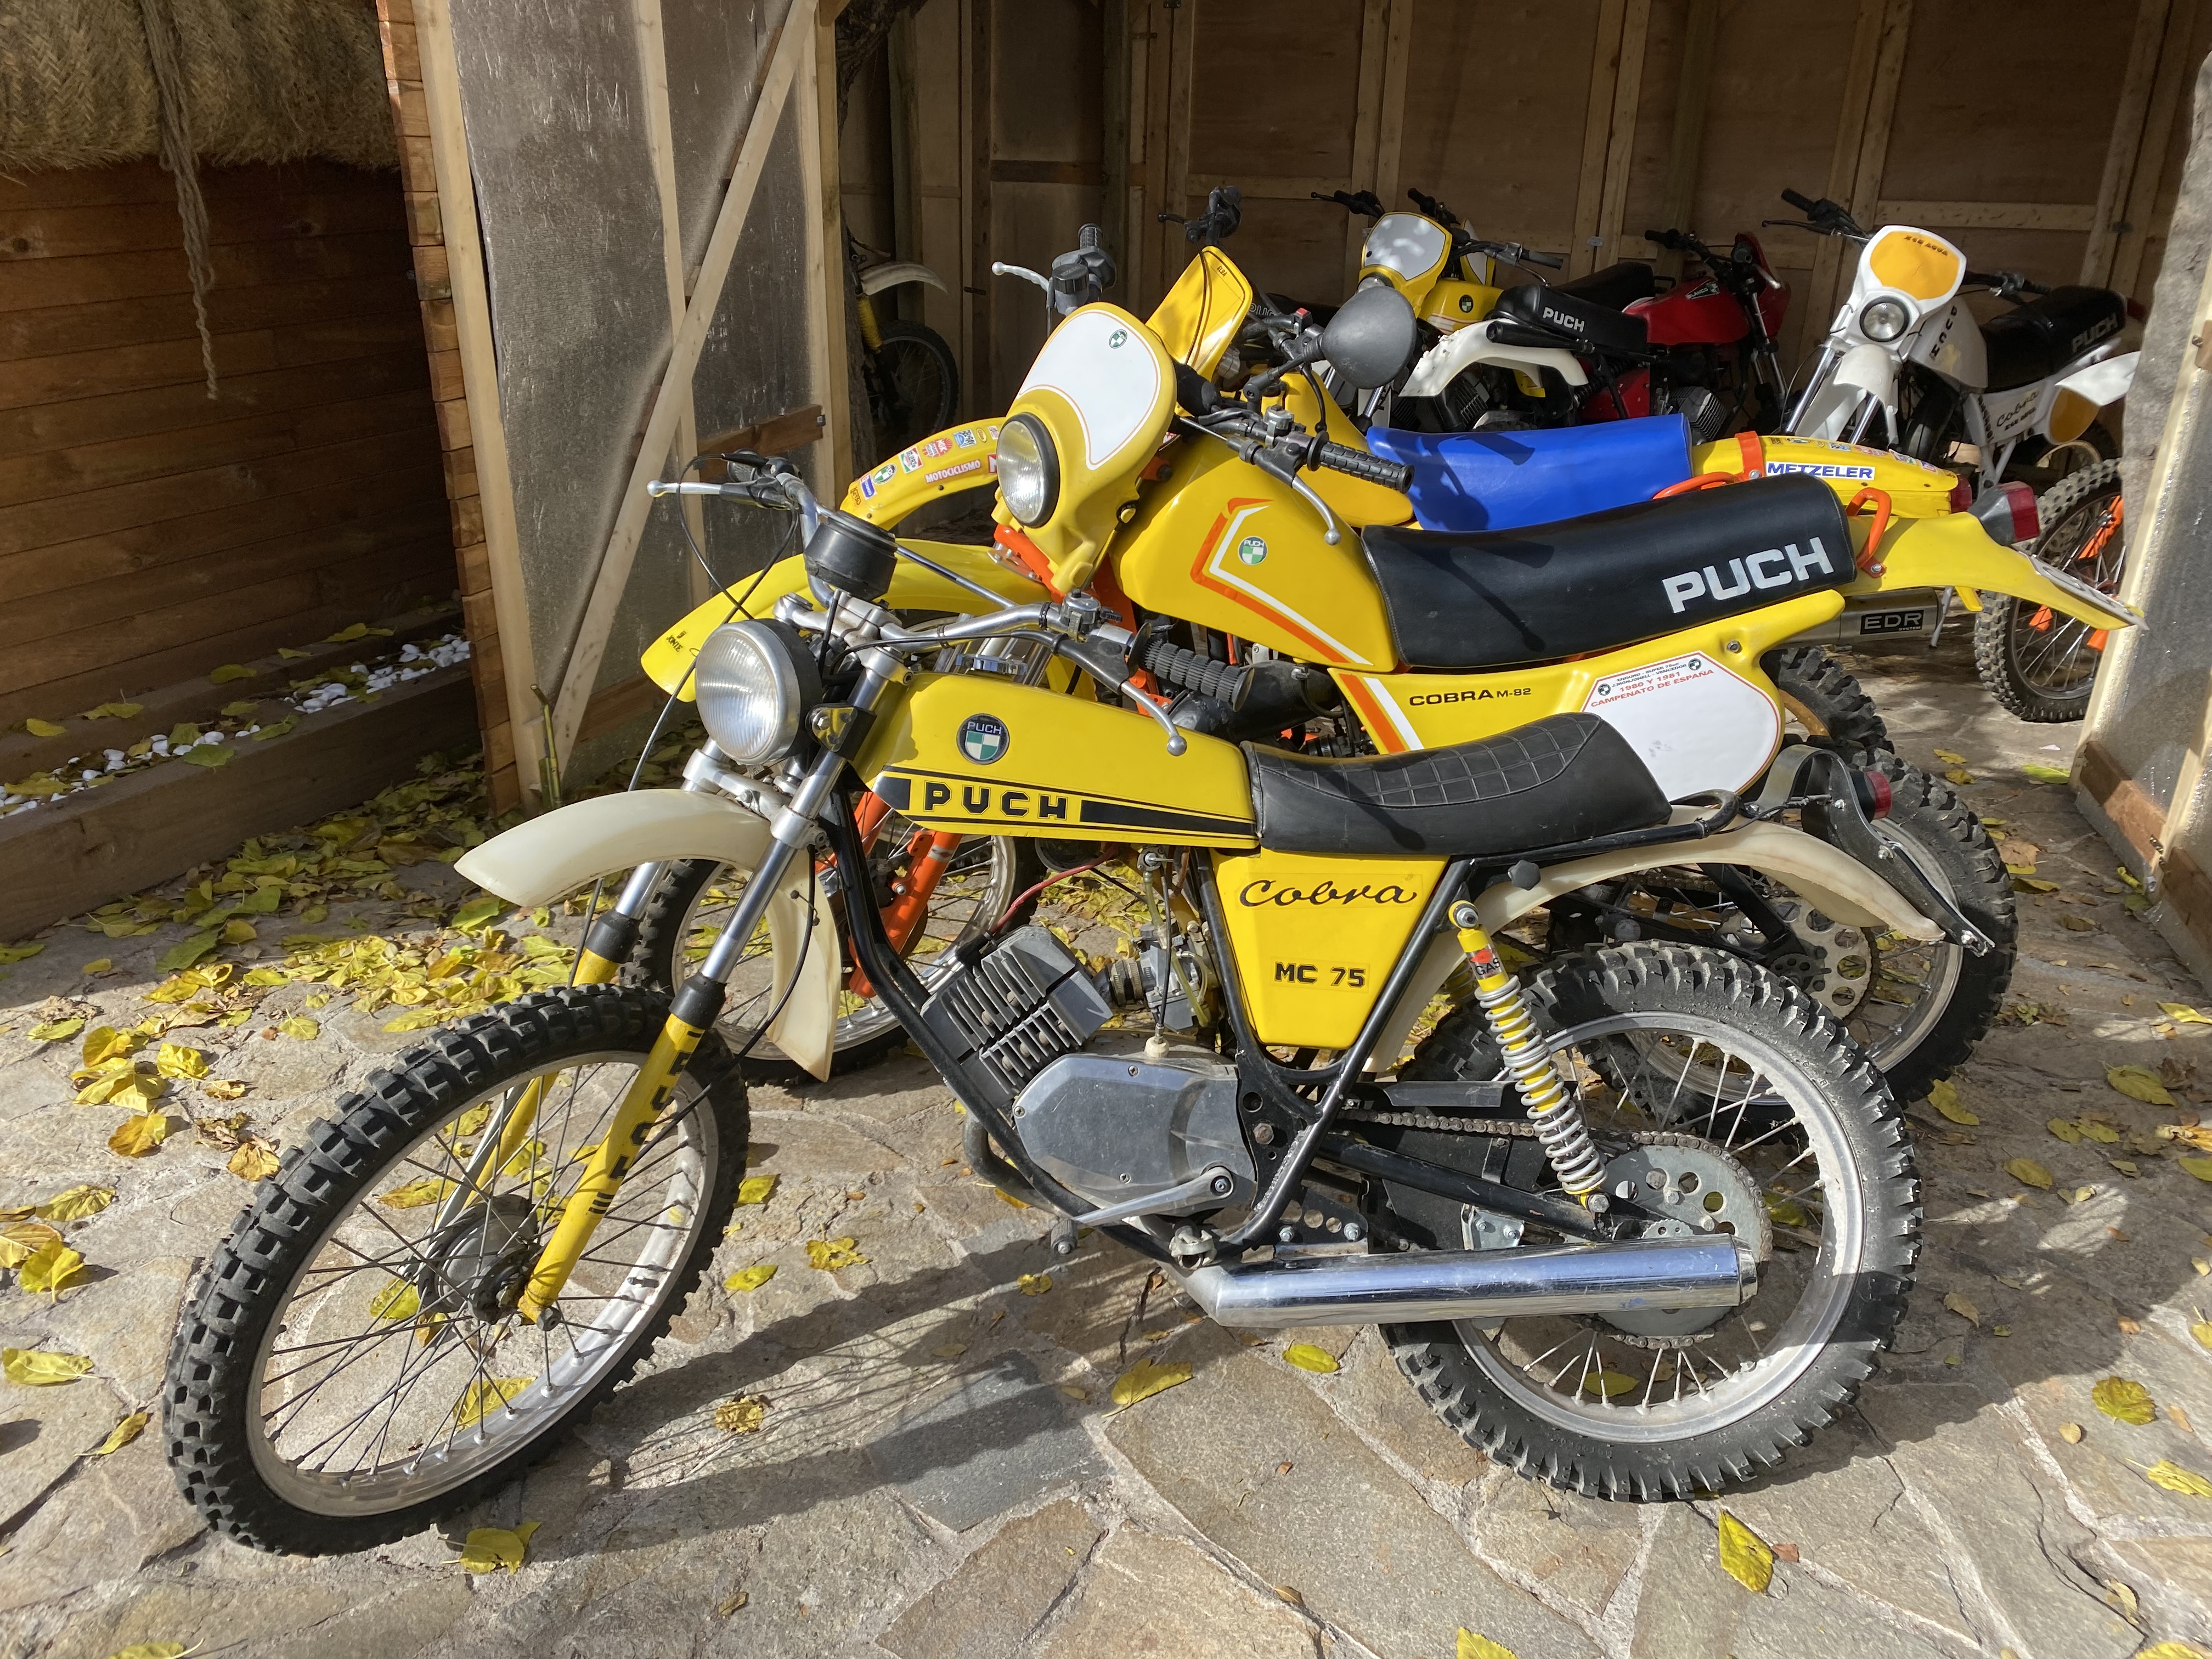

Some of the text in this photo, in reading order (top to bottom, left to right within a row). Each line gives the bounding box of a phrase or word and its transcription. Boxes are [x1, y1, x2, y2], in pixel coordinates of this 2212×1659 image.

[1542, 307, 1585, 333] PUCH
[2072, 312, 2118, 353] PUCH
[1996, 390, 2040, 427] Cobra
[930, 443, 938, 454] SPARK
[936, 439, 948, 453] NGK
[924, 459, 981, 483] MOTOCICLISMO
[1768, 462, 1874, 478] METZELER
[1244, 539, 1265, 548] PUCH
[1662, 537, 1835, 614] PUCH
[1864, 612, 1922, 630] EDR
[1617, 672, 1641, 682] ENDURO
[1645, 666, 1664, 674] SUPER
[1656, 663, 1688, 675] VENCEDOR
[1591, 686, 1655, 707] CAMPENATO
[1673, 668, 1714, 685] ESPAÑA
[1620, 681, 1644, 692] 1980
[1657, 672, 1680, 682] 1981
[1409, 687, 1532, 706] COBRA M-82
[967, 721, 1002, 735] PUCH
[923, 780, 1069, 821] PUCH
[1239, 879, 1417, 907] Cobra
[1274, 961, 1366, 989] MC 75
[1475, 957, 1500, 975] GAS
